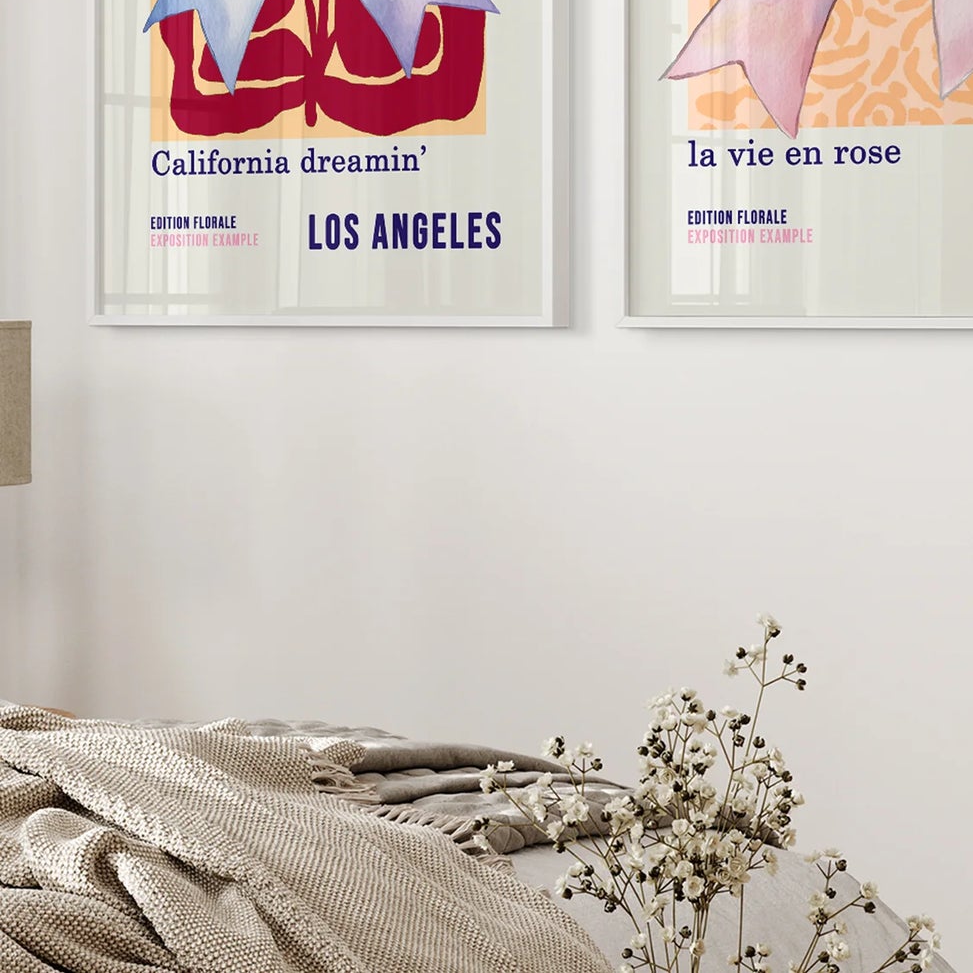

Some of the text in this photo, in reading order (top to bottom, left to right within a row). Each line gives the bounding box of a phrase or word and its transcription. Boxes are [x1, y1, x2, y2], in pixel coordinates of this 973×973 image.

[688, 139, 901, 167] la vie en rose
[151, 149, 290, 176] California
[151, 216, 237, 229] EDITION FLORALE
[688, 210, 787, 225] EDITION FLORALE
[309, 212, 502, 250] LOS ANGELES
[688, 229, 813, 244] EXPOSITION EXAMPLE
[151, 233, 259, 247] EXPOSITION EXAMPLE
